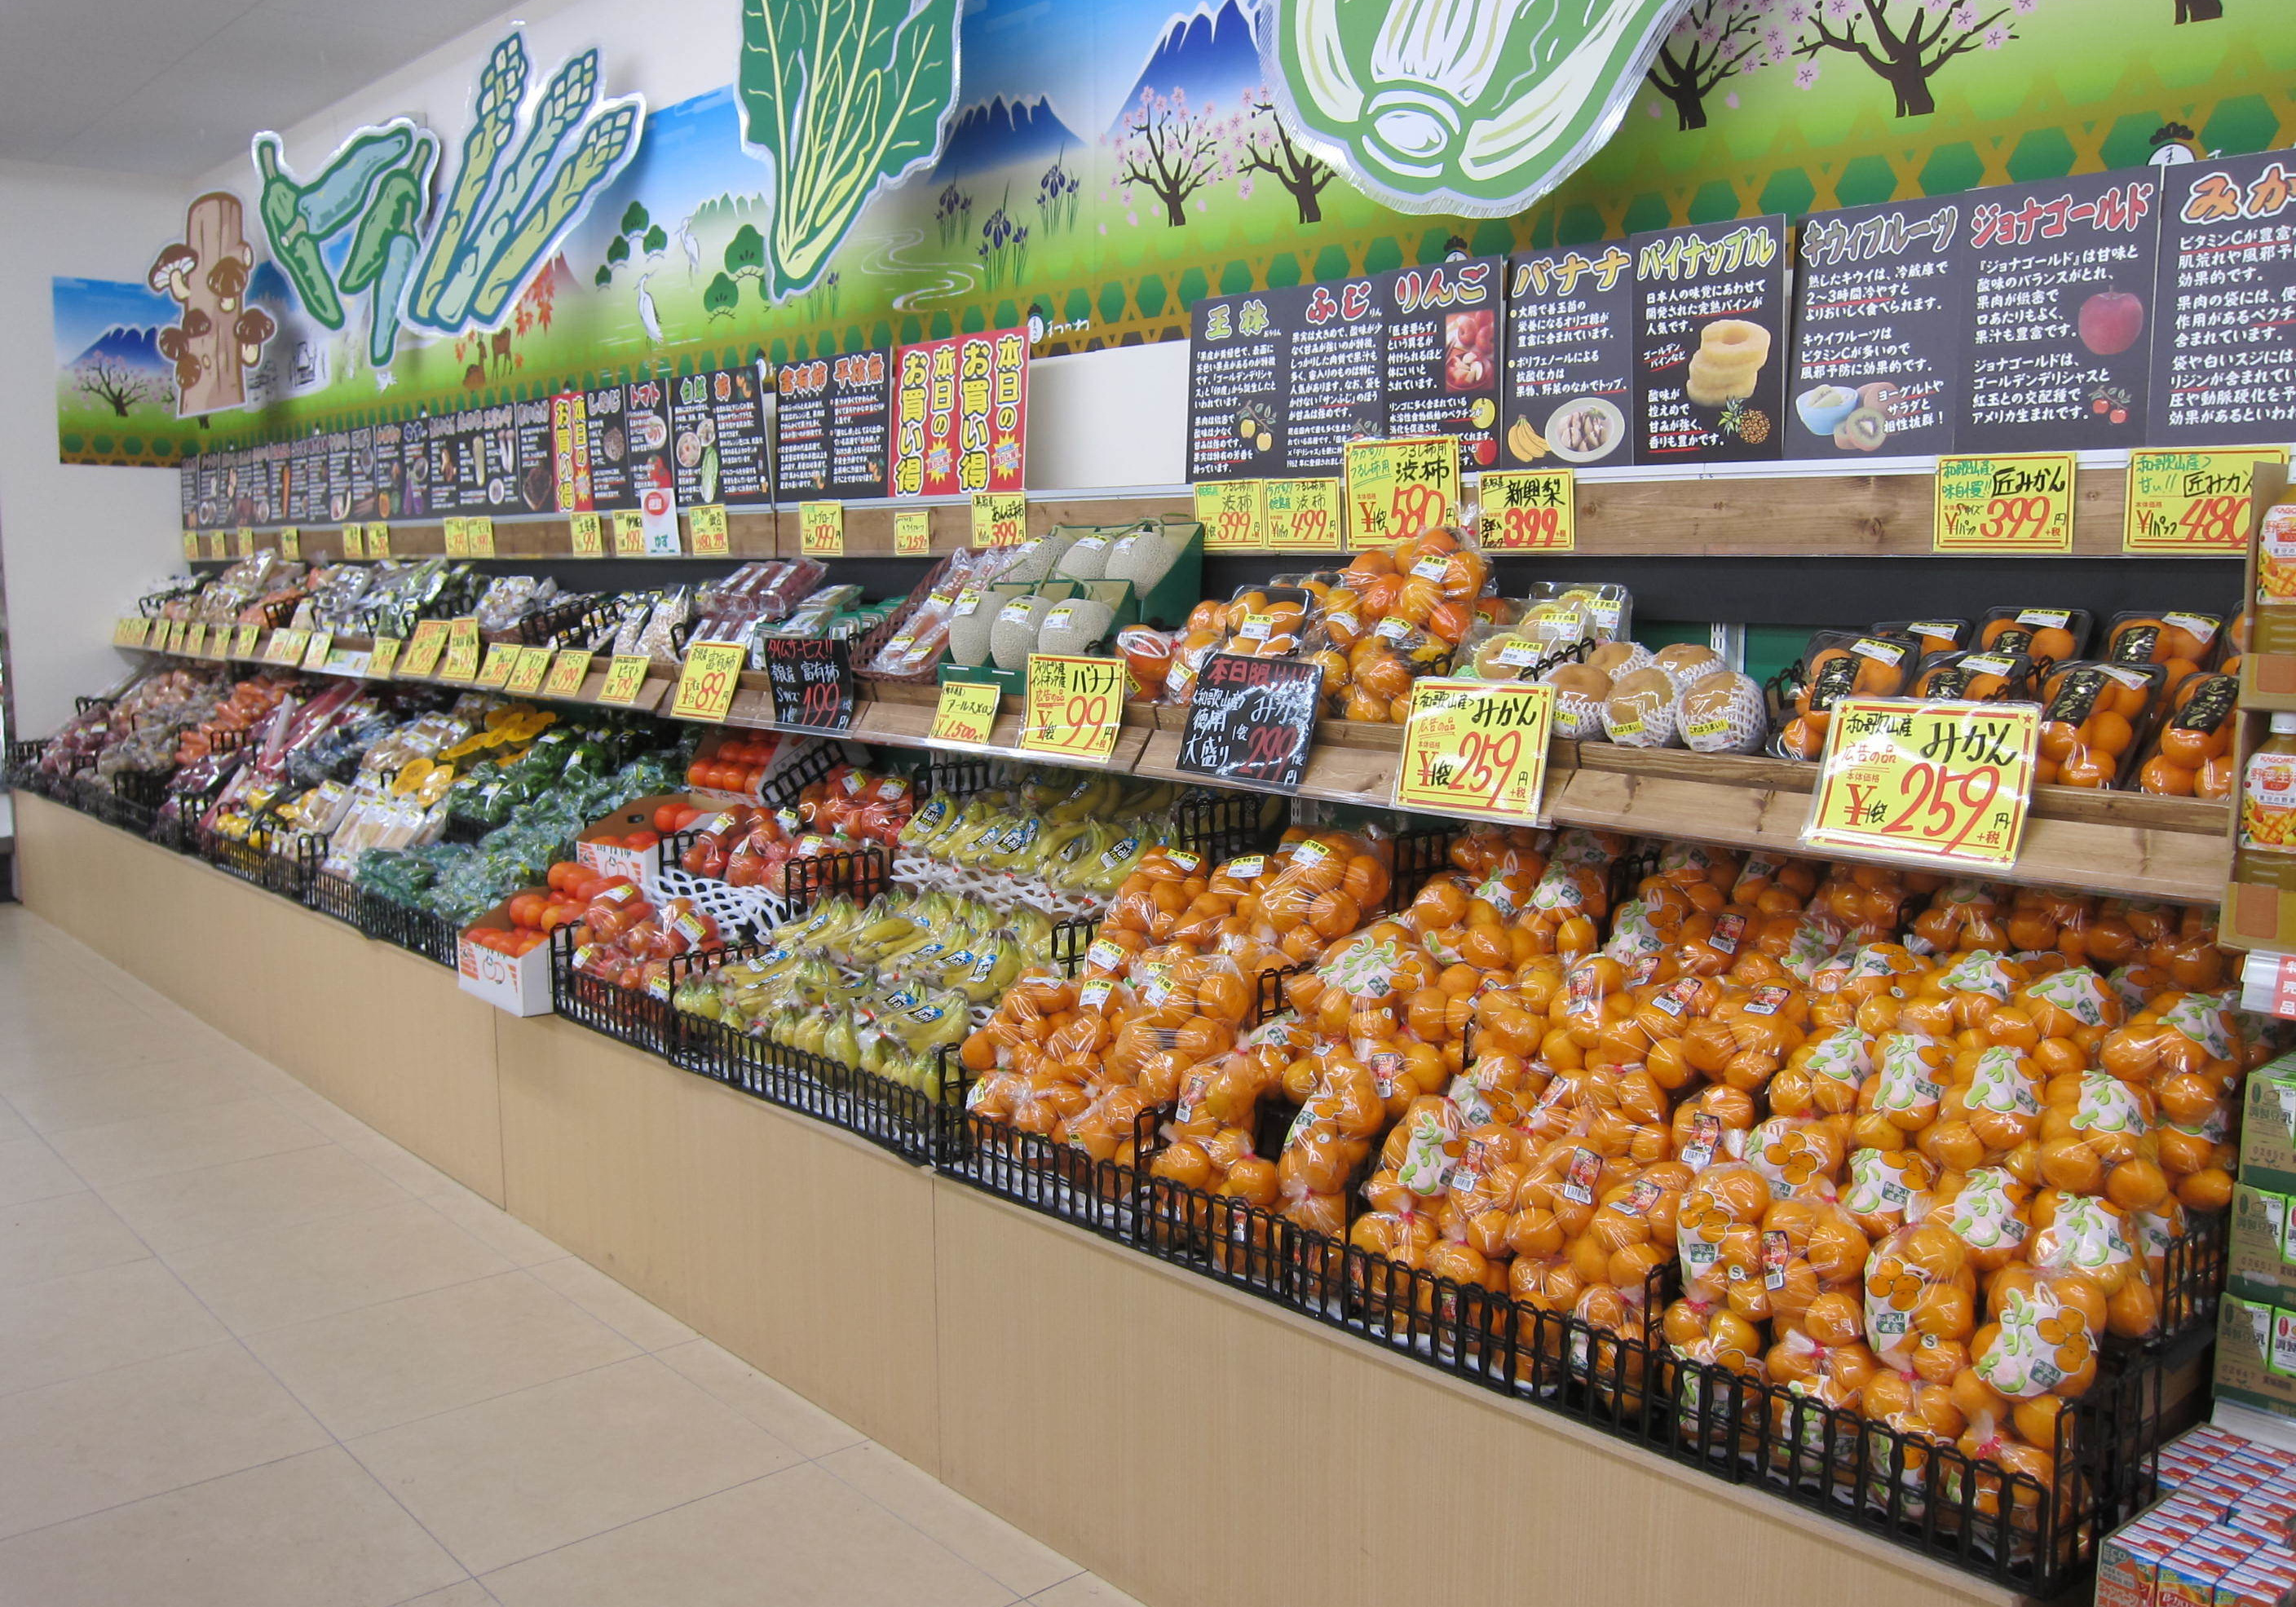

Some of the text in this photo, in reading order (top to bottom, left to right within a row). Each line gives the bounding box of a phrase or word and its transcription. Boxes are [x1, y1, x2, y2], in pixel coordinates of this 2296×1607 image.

[2180, 162, 2296, 226] みか
[1971, 182, 2154, 249] ジョナゴールド
[2179, 224, 2296, 250] ビタミンCが豊富
[1636, 226, 1777, 282] パイナップル
[2177, 245, 2296, 270] 肌荒れや風邪予
[1512, 245, 1632, 299] バナナ
[1807, 261, 1948, 289] 熟したキウイは、冷蔵庫で
[2177, 267, 2263, 288] 効果的です。
[1395, 264, 1490, 315] りんご
[1645, 279, 1767, 305] 日本人の味覚にあわせて
[1976, 289, 2059, 310] 果肉が緻密で
[1306, 280, 1373, 325] ふじ
[1645, 296, 1763, 321] 開発された完熟パインが
[1804, 295, 1942, 322] よりおいしく食べられます。
[1205, 299, 1269, 341] 王林
[1645, 320, 1693, 337] 人気です。
[1388, 336, 1433, 351] という異名が
[1517, 328, 1614, 348] 豊富に含まれています。
[1802, 327, 1892, 348] キウイフルーツは
[1974, 324, 2077, 346] 果汁も豊富です。
[2174, 326, 2283, 348] 含まれています。
[1388, 349, 1442, 364] 付けられるほど
[1517, 351, 1600, 369] ポリフェノールによる
[1643, 342, 1681, 360] ゴールデン
[1649, 351, 1686, 369] パインなど
[1801, 342, 1911, 364] ビタミンCが多いので
[1388, 365, 1427, 378] 体にいいと
[1516, 368, 1565, 383] 抗酸化力は
[1800, 359, 1932, 381] 風邪予防に効果的です。
[1973, 354, 2081, 374] ジョナゴールドは、
[931, 344, 958, 437] 本日の
[995, 333, 1024, 430] 本日の
[1388, 377, 1437, 392] されています。
[1516, 379, 1627, 398] 果物、野菜のなかでトップ。
[1879, 379, 1945, 401] ヨーグルトや
[1973, 368, 2110, 391] ゴールデンデリシャスと
[1648, 388, 1680, 403] 酸味が
[1888, 399, 1931, 415] サラダと
[1972, 388, 2082, 408] 紅玉との交配種で
[958, 338, 992, 494] お買い得
[1648, 403, 1690, 417] 控えめで
[1971, 407, 2089, 425] アメリカ生まれです。
[572, 395, 587, 467] 本日の
[894, 350, 931, 497] お買い得
[1648, 418, 1702, 433] 甘みが強く、
[1648, 433, 1724, 449] 香りも豊かです。
[554, 398, 576, 513] お買い得
[1395, 456, 1450, 489] 渋柿
[1990, 466, 2066, 499] 匠みかん
[1384, 483, 1446, 540] 580
[1979, 495, 2051, 540] 399
[991, 520, 1018, 547] 399
[1217, 511, 1252, 541] 399
[1291, 509, 1327, 541] 499
[1503, 507, 1559, 549] 399
[800, 660, 841, 684] 富有柿
[1072, 664, 1120, 695] バナナ
[695, 672, 726, 713] 89
[947, 698, 996, 715] アールスメロン
[1471, 695, 1538, 728] みかん
[1062, 695, 1107, 751] 99
[1845, 711, 1914, 738] 和歌山産
[1183, 735, 1230, 768] 大盛り
[1841, 740, 1898, 765] 広告の品
[1919, 722, 2018, 766] みかん
[1447, 730, 1522, 808] 259
[1846, 772, 1880, 784] 本体価格
[1880, 762, 2000, 855] 259
[1993, 812, 2011, 830] 円
[1732, 1267, 1741, 1278] S
[1926, 1335, 1935, 1347] S
